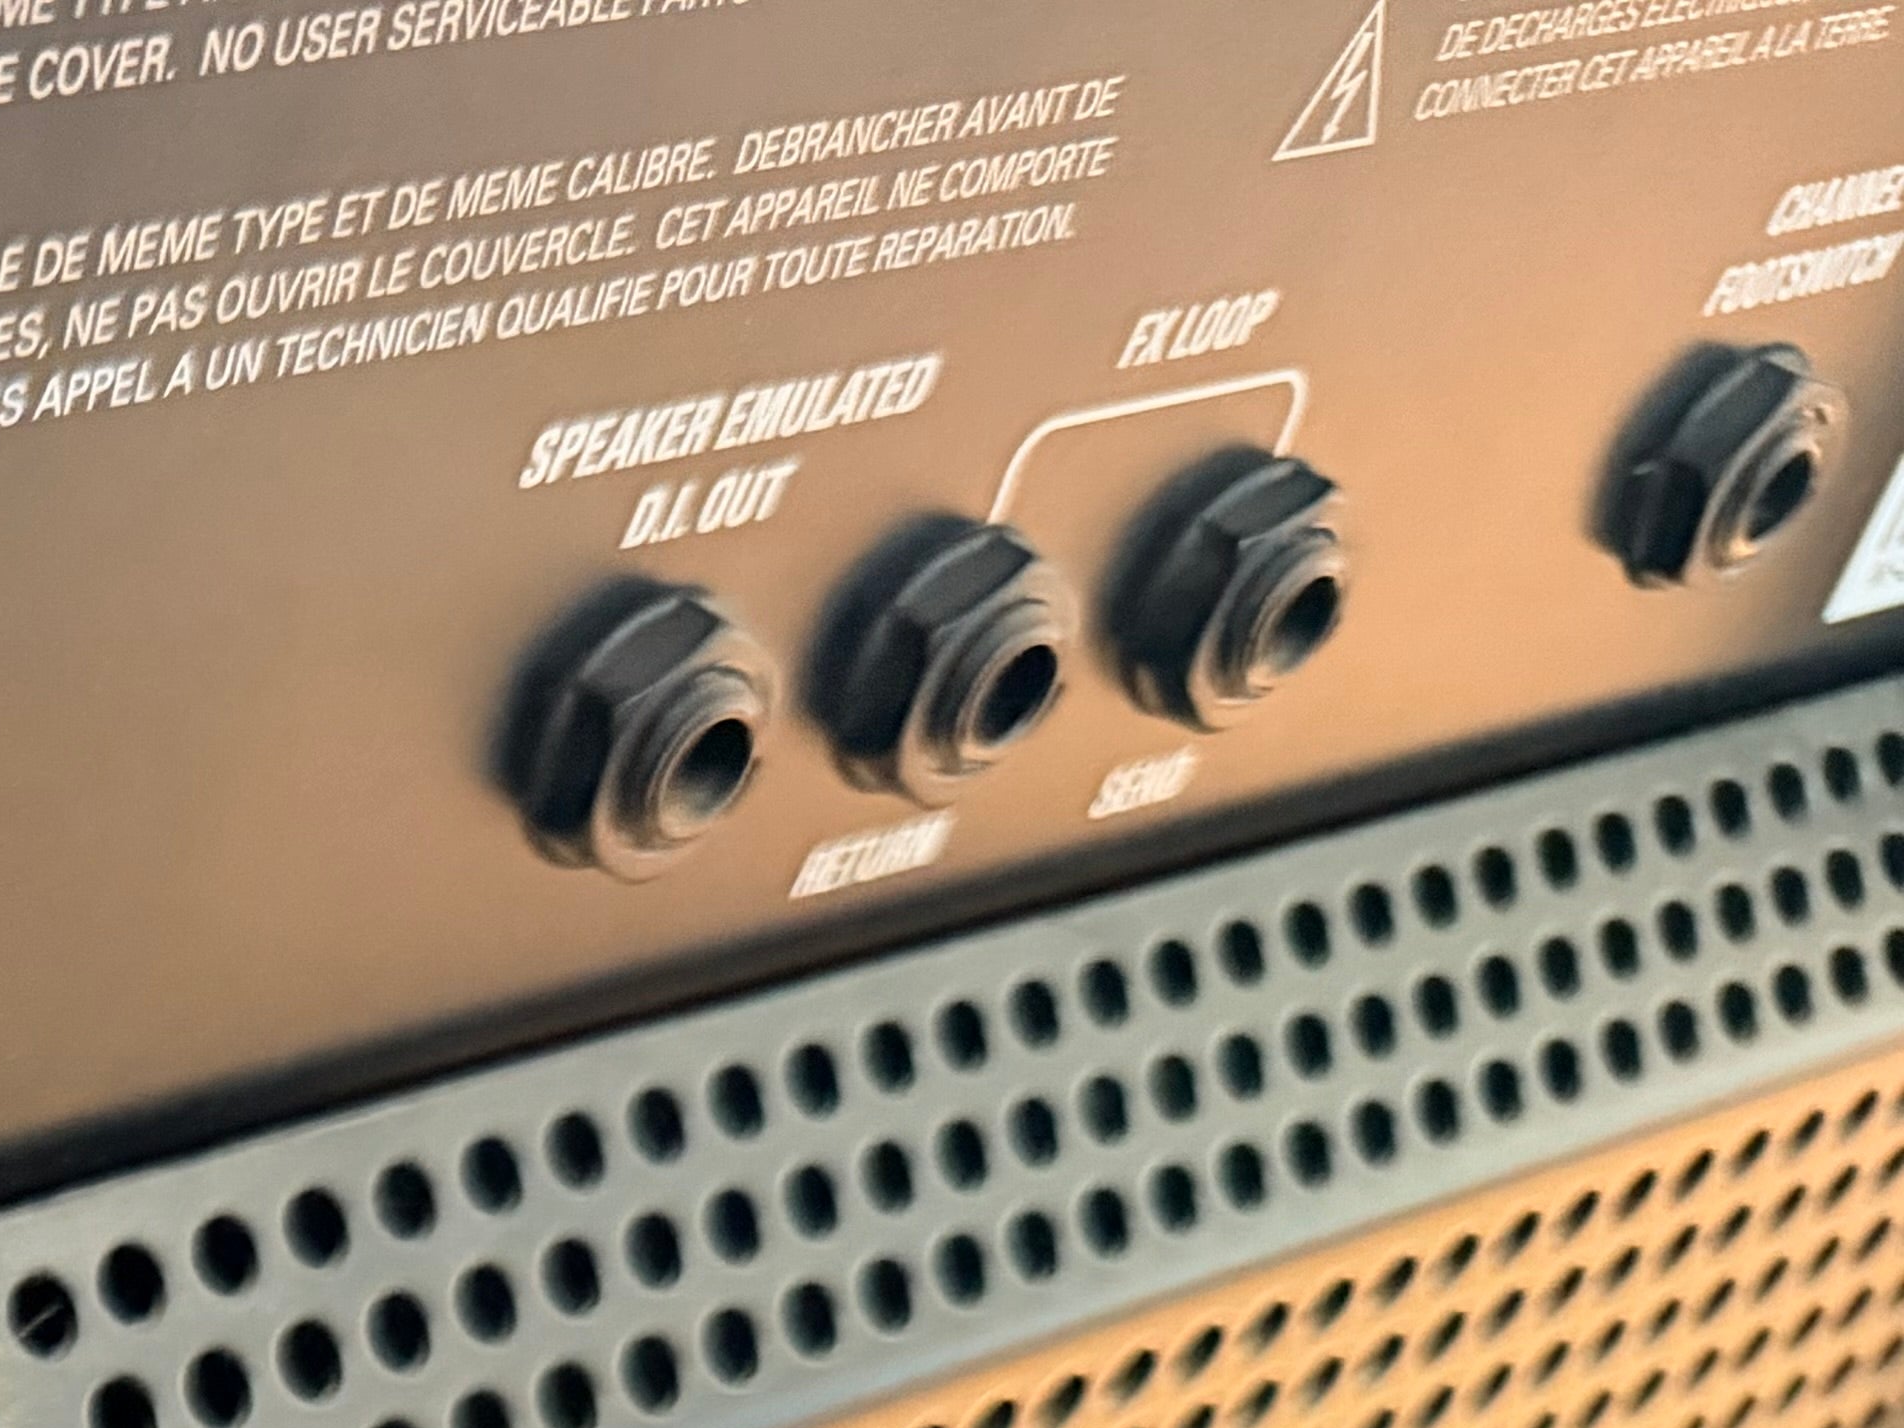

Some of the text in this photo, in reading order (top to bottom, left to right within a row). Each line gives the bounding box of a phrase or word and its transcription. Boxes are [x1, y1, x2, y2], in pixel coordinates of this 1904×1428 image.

[28, 33, 176, 100] COVER.
[198, 21, 266, 77] NO
[273, 7, 382, 67] USER
[1435, 19, 1485, 62] DE
[1476, 0, 1641, 55] DECHARGES
[1628, 30, 1751, 82] APPAREIL
[31, 232, 91, 287] DE
[96, 210, 223, 277] MEME
[232, 194, 329, 255] TYPE
[330, 187, 388, 239] ET
[387, 177, 445, 231] DE
[445, 160, 565, 221] MEME
[566, 137, 717, 201] CALIBRE.
[732, 100, 962, 175] DEBRANCHER
[956, 82, 1080, 139] AVANT
[1072, 74, 1126, 122] DE
[1766, 164, 1904, 236] CHANNE
[62, 295, 122, 350] NE
[127, 280, 210, 339] PAS
[215, 256, 364, 325] OUVRIR
[365, 247, 417, 299] LE
[419, 213, 636, 290] COUVERCLE.
[655, 198, 729, 251] CET
[722, 174, 880, 239] APPAREIL
[885, 164, 942, 211] NE
[938, 135, 1119, 202] COMPORTE
[31, 359, 156, 421] APPEL
[162, 349, 195, 399] A
[205, 338, 269, 391] UN
[276, 301, 494, 378] TECHNICIEN
[496, 271, 658, 340] QUALIFIE
[656, 255, 759, 310] POUR
[762, 234, 875, 292] TOUTE
[871, 202, 1076, 273] REPARATION.
[1115, 288, 1280, 370] FX LOOP
[518, 352, 942, 489] SPEAKER EMULATED
